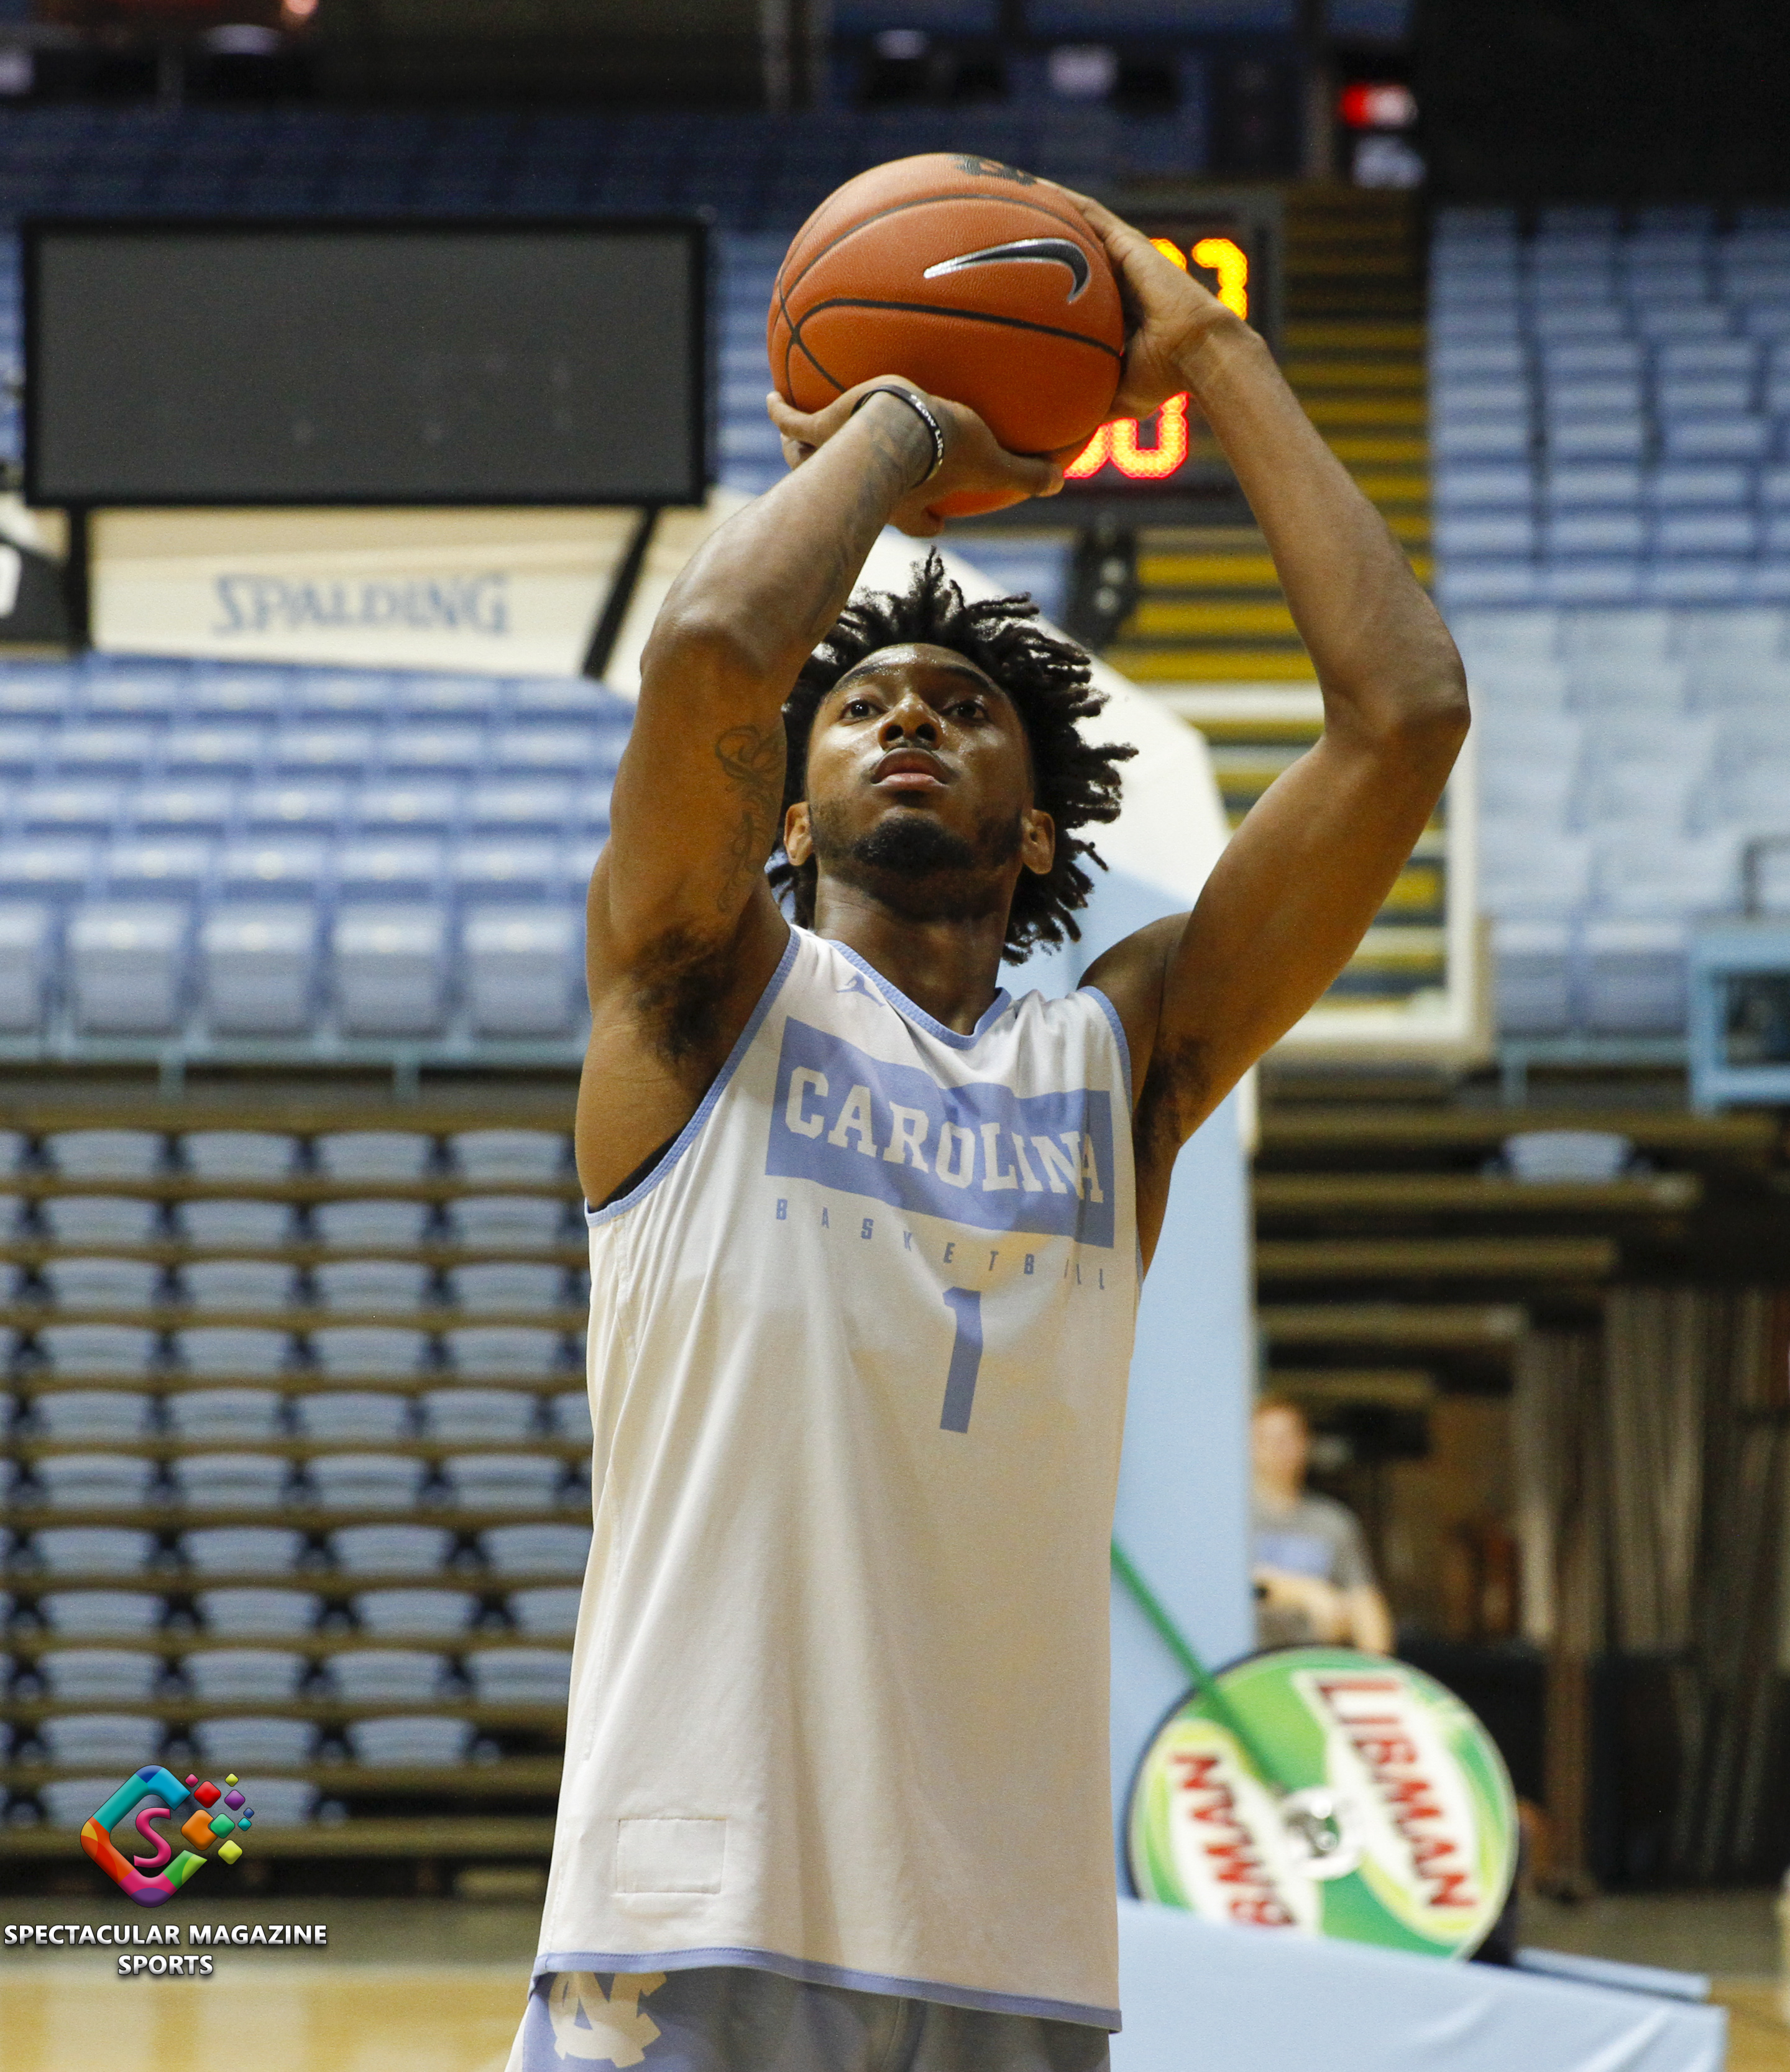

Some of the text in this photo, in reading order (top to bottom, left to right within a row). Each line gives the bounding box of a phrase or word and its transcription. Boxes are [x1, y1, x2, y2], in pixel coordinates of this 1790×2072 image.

[211, 572, 508, 636] SPALDING
[786, 1066, 1104, 1203] CAROLINA
[940, 1286, 983, 1434] 1
[1318, 1677, 1477, 1907] LIBMAN
